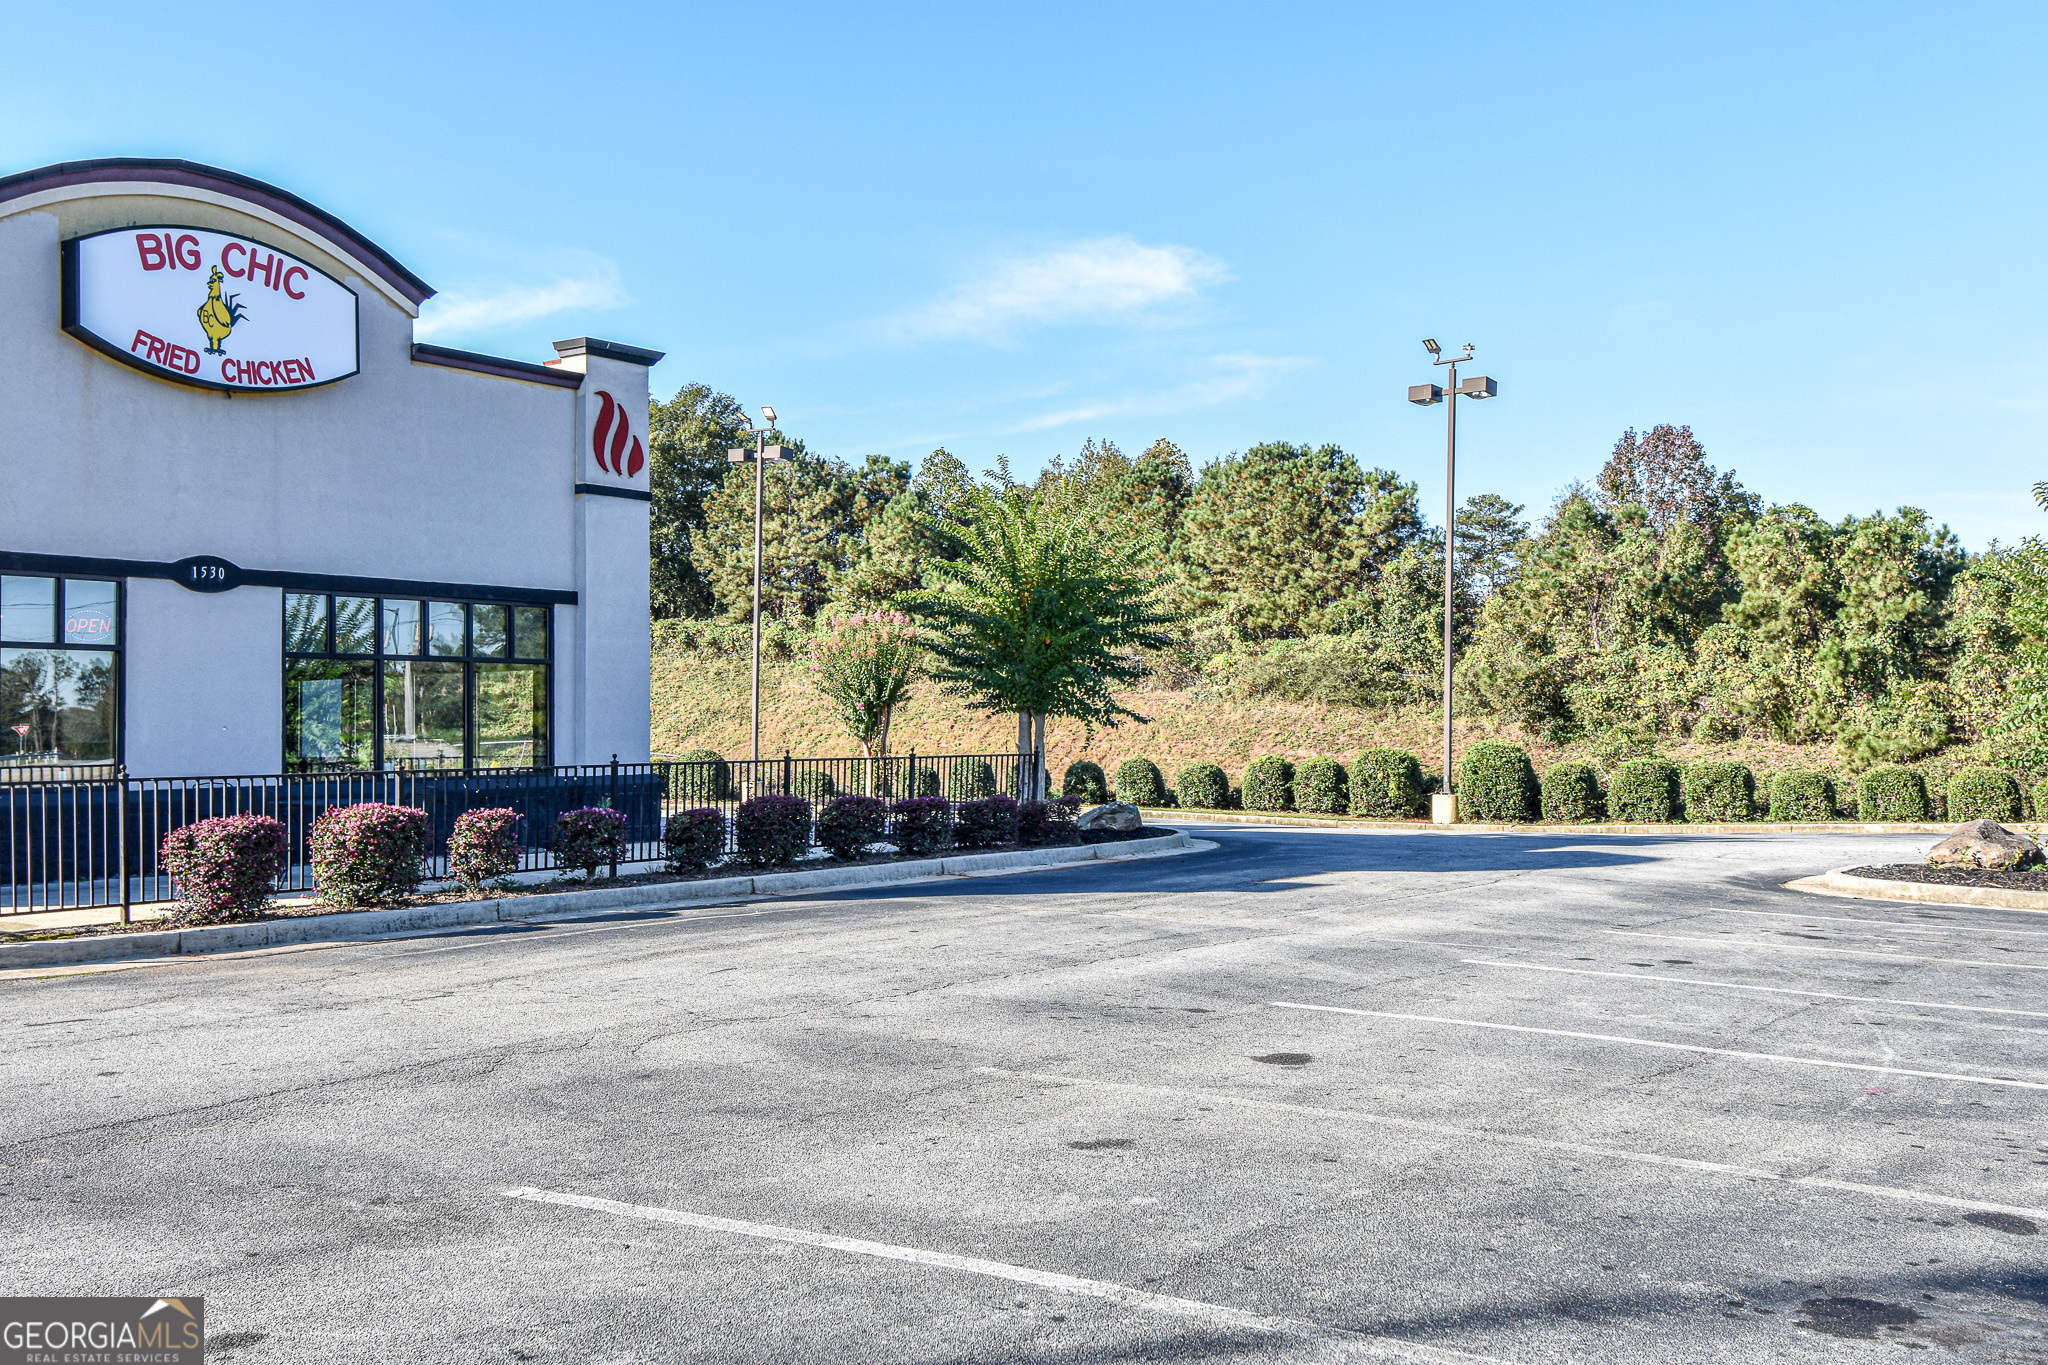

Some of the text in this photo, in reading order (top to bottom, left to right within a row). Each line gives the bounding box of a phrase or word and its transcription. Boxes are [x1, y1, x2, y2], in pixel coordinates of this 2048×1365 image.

[135, 232, 309, 300] BIG CHIC
[202, 309, 215, 328] BC
[131, 329, 316, 385] FRIED CHICKEN
[192, 566, 225, 580] 1530
[66, 618, 111, 633] OPEN
